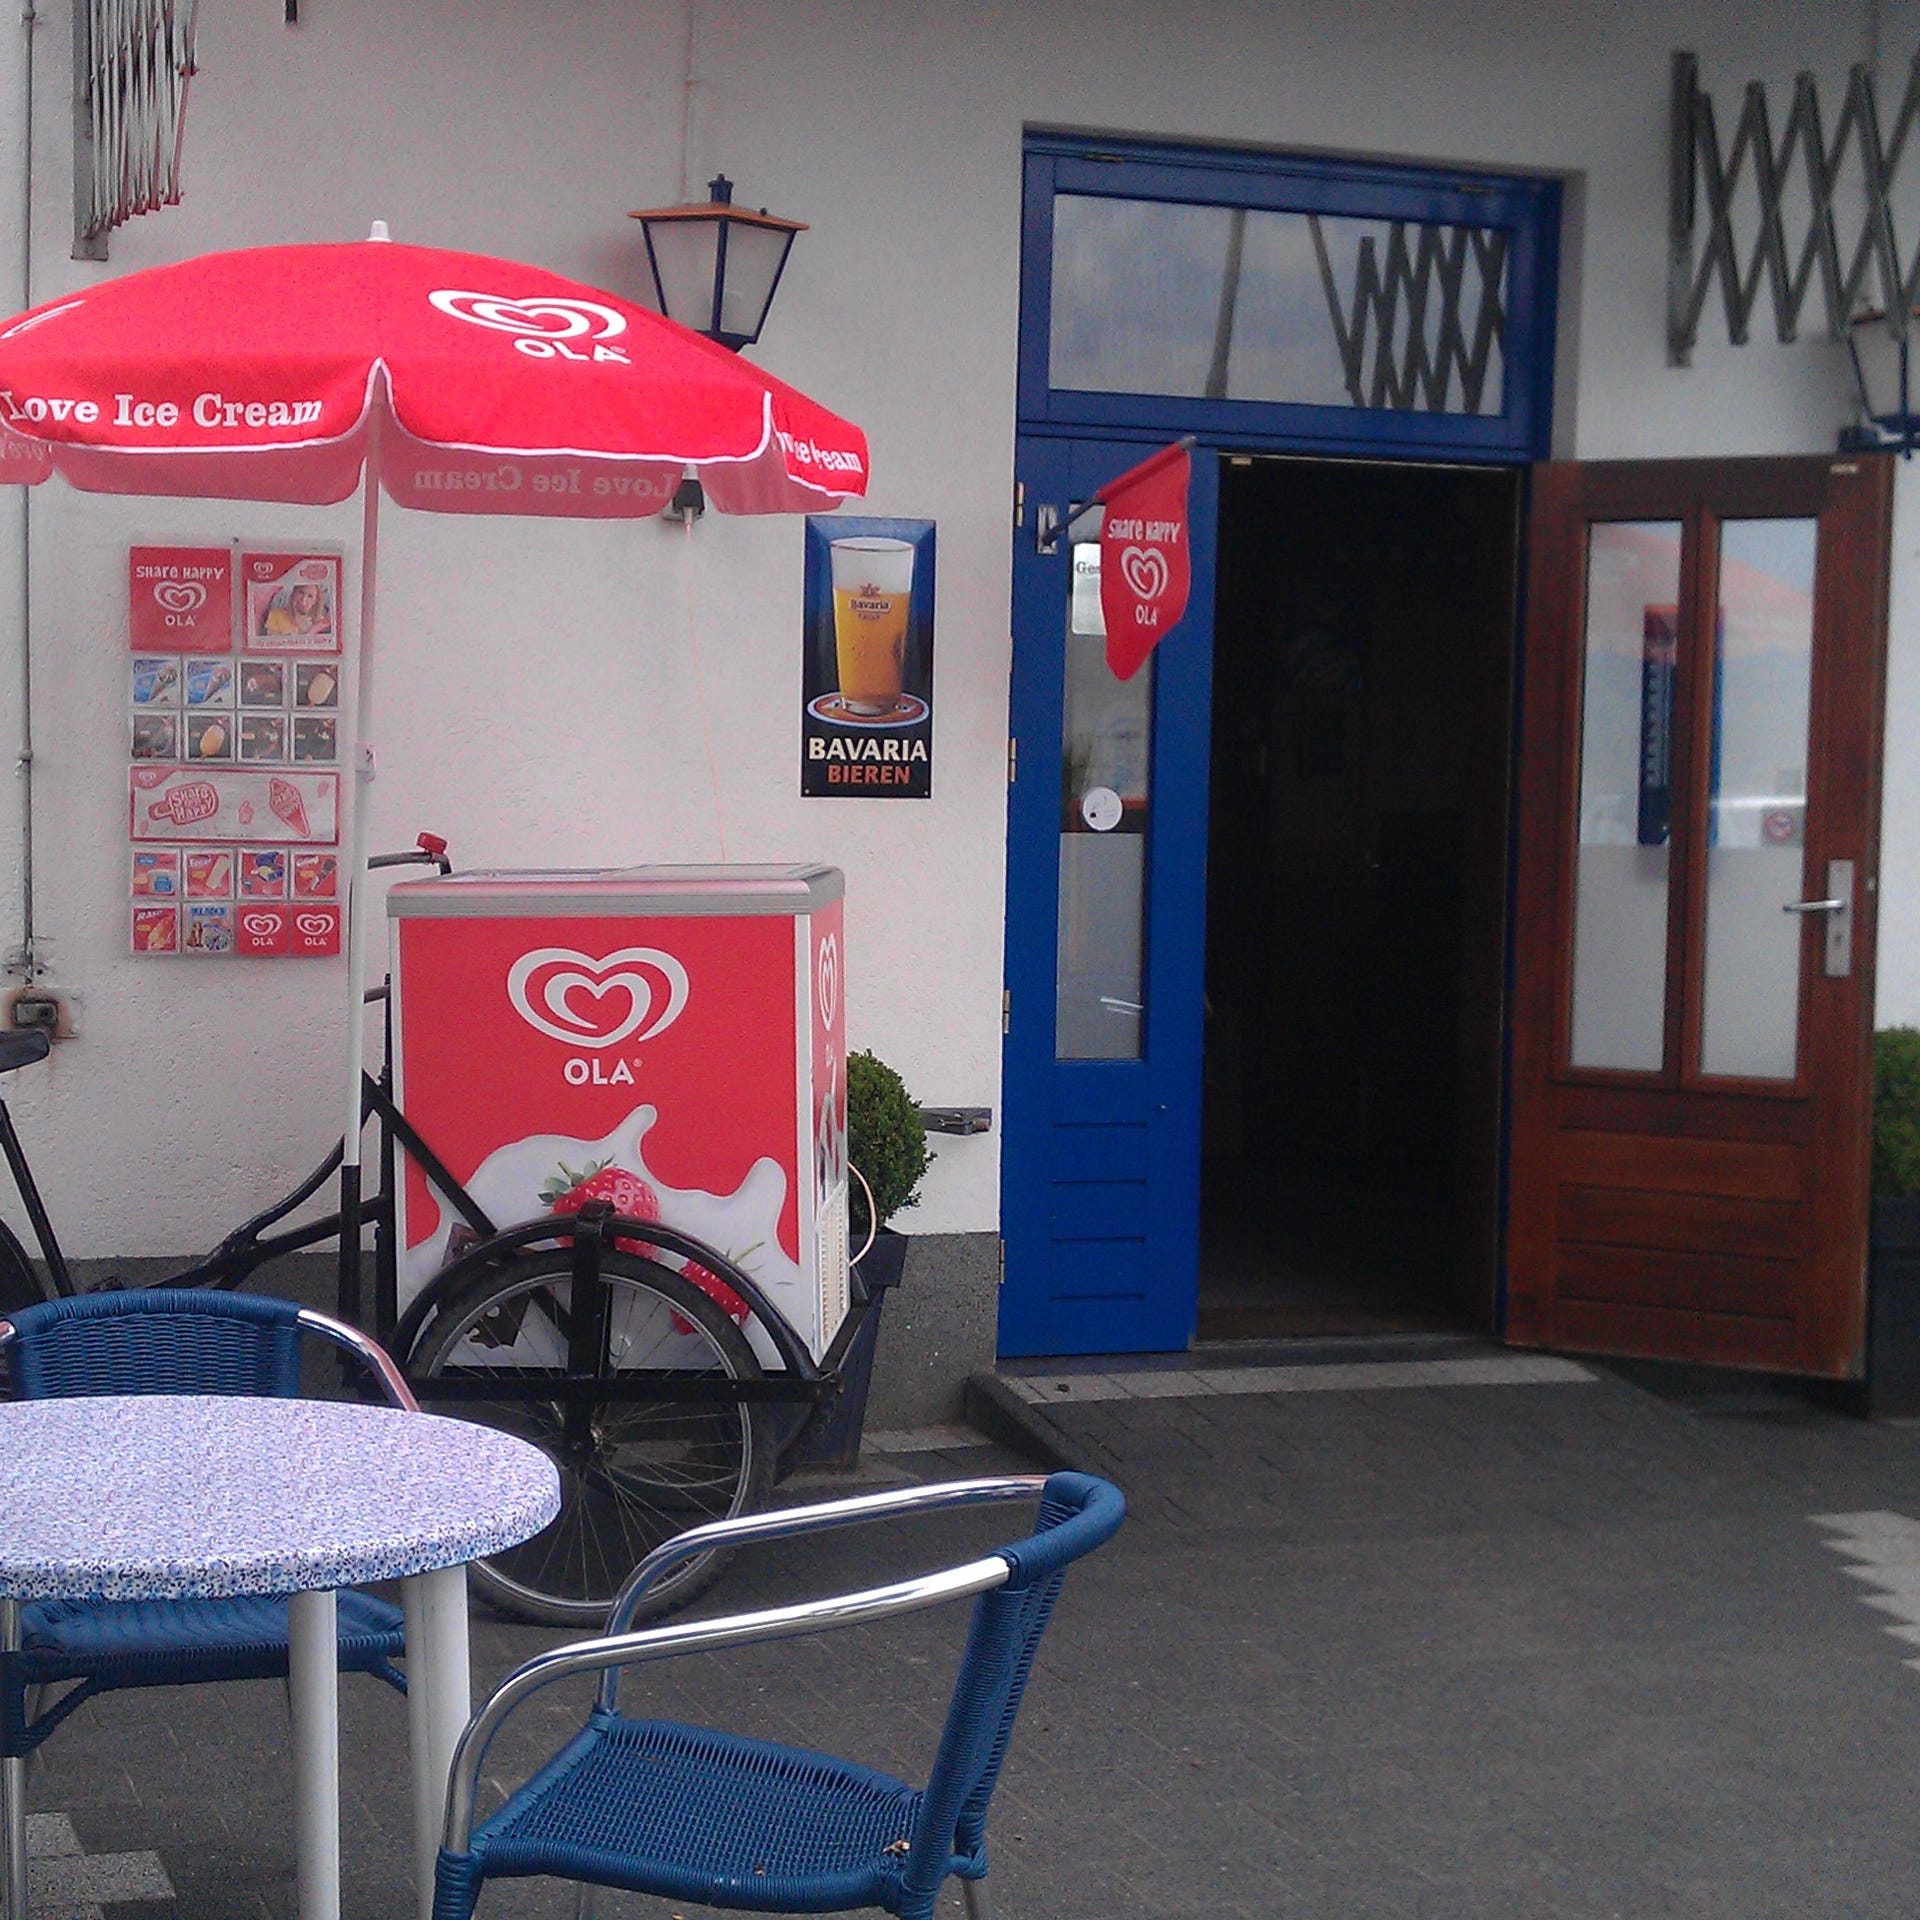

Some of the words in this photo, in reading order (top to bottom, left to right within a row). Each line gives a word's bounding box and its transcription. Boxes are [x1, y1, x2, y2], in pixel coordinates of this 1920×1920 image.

[513, 339, 632, 365] OLA
[1, 391, 99, 421] Love
[113, 394, 178, 426] Ice
[193, 393, 322, 427] Cream
[850, 599, 890, 610] Bavaria
[1135, 604, 1157, 625] OLA
[165, 615, 195, 626] OLA
[809, 737, 928, 762] BAVARIA
[827, 765, 911, 784] BIEREN
[252, 936, 274, 946] OLA
[304, 936, 327, 946] OLA
[564, 1058, 635, 1085] OLA
